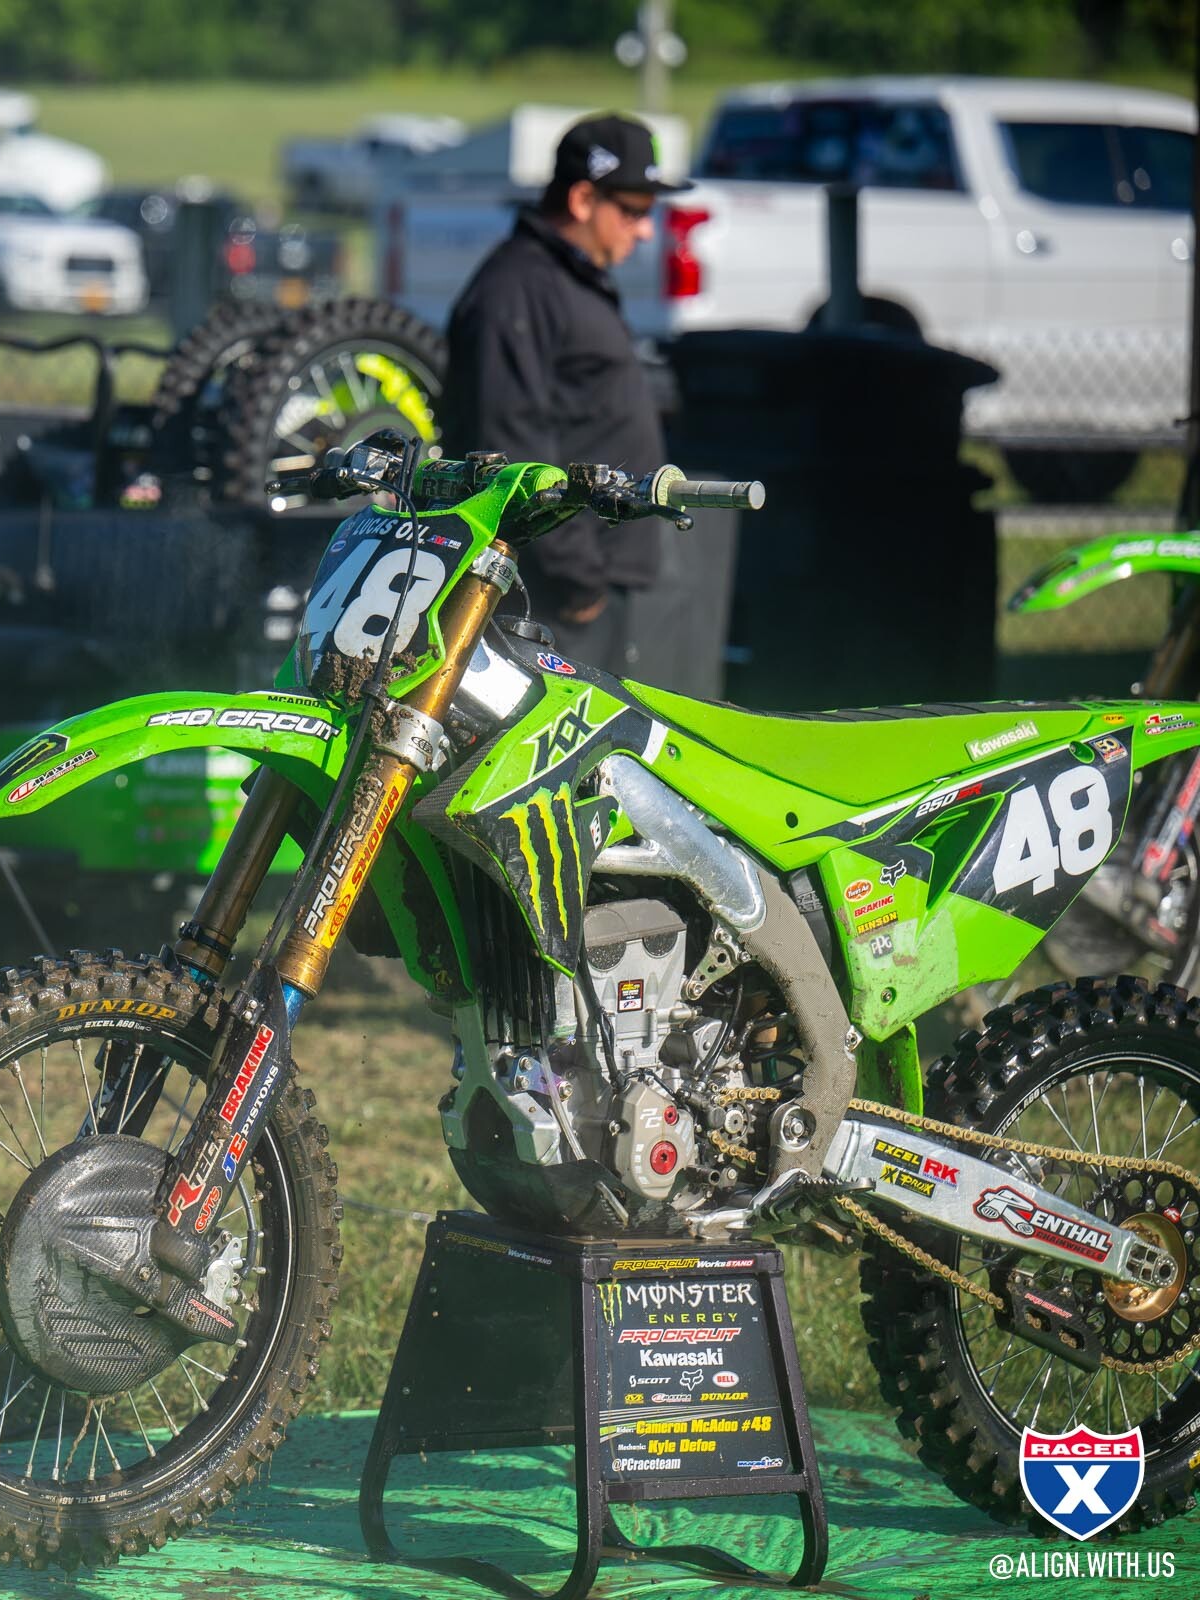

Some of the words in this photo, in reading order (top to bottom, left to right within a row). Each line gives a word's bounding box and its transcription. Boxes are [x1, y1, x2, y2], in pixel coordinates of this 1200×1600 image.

[352, 516, 399, 537] LUCAS
[300, 538, 447, 663] 48
[215, 708, 343, 744] CIRCUIT
[969, 723, 1038, 758] Kawasaki
[351, 785, 400, 890] SHOWA
[993, 765, 1113, 896] 48
[303, 871, 338, 939] PRO
[854, 895, 894, 918] BRAKING
[857, 911, 898, 935] HINSON
[56, 997, 177, 1021] DUNLOP
[219, 1023, 275, 1125] BRAKING
[241, 1064, 279, 1138] PISTONS
[875, 1141, 921, 1165] EXCEL
[923, 1157, 960, 1184] RK
[195, 1185, 222, 1234] GUTS
[625, 1281, 757, 1309] MONSTER
[648, 1312, 738, 1324] ENERGY
[617, 1328, 664, 1346] PRO
[661, 1327, 742, 1345] CIRCUIT
[639, 1347, 724, 1367] Kawasaki
[636, 1377, 671, 1385] SCOTT
[716, 1375, 734, 1383] BELL
[701, 1392, 749, 1401] DUNLOP
[636, 1420, 688, 1435] Cameron
[690, 1418, 739, 1433] McAdoo
[741, 1416, 772, 1432] #48
[647, 1440, 676, 1456] Kyle
[679, 1438, 717, 1453] Defoe
[611, 1458, 681, 1472] @PCraceteam
